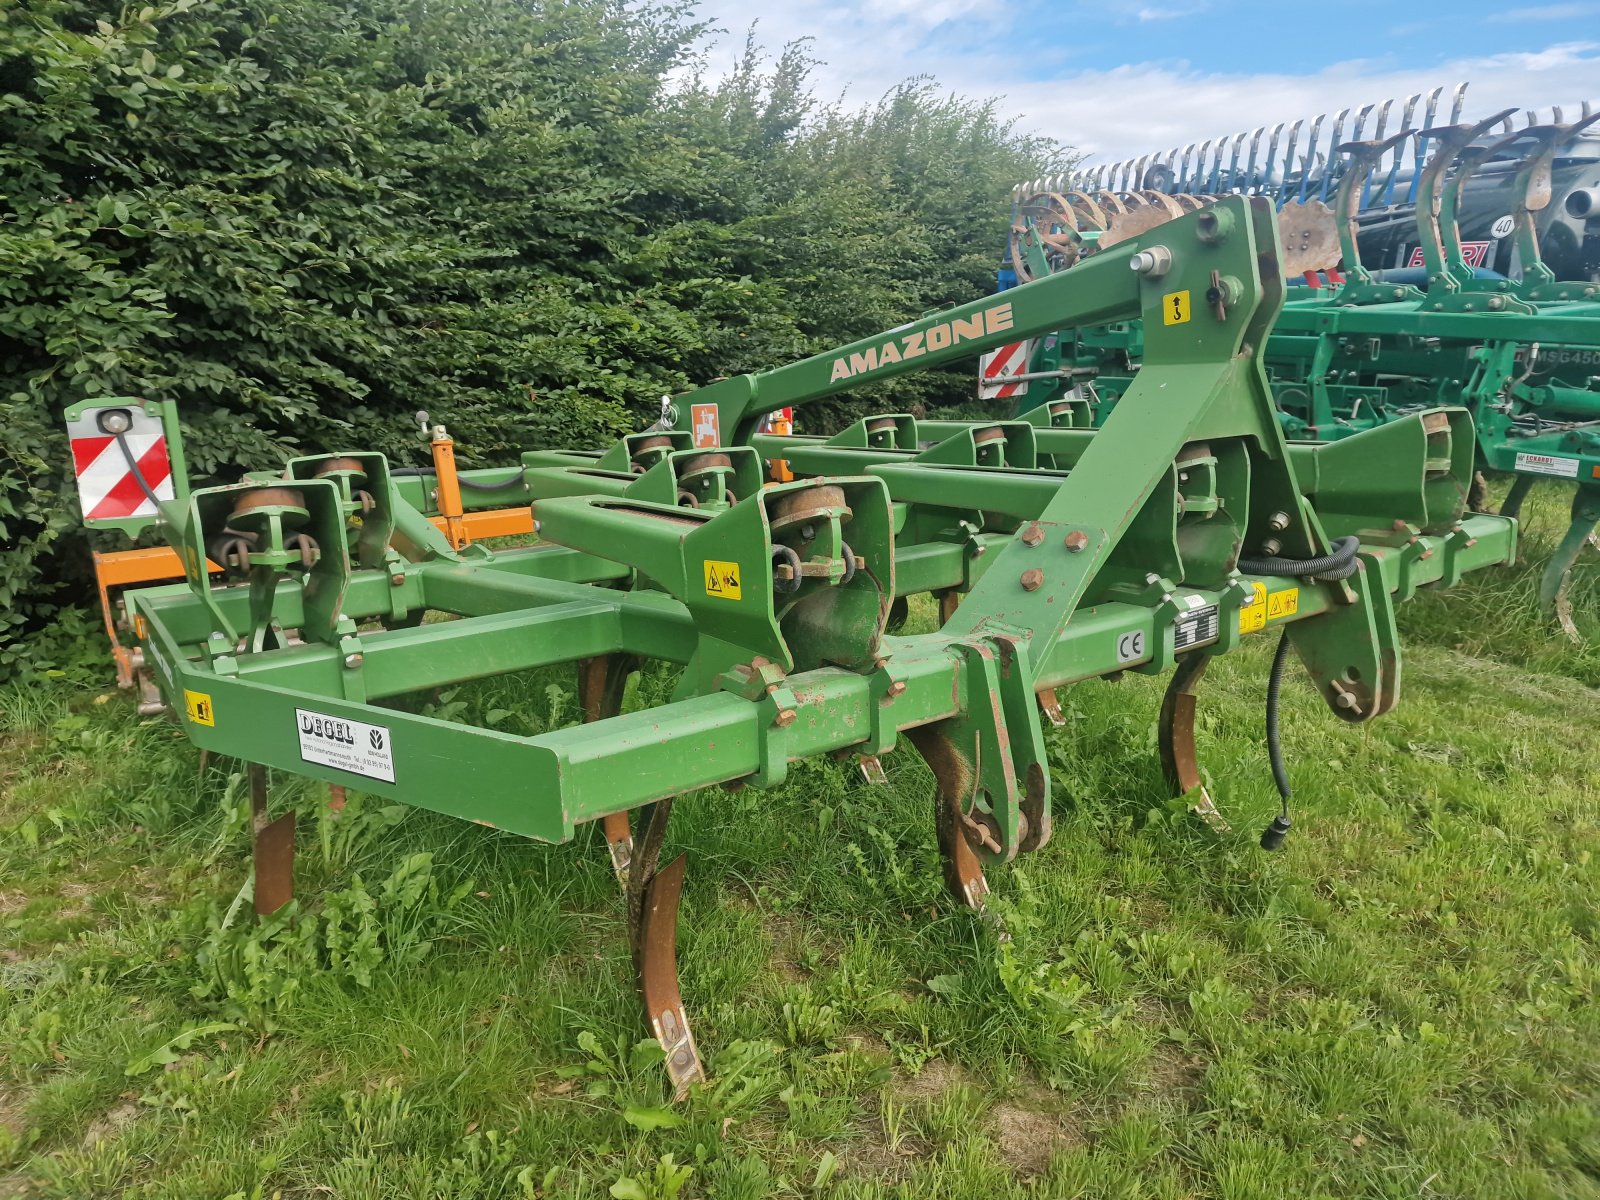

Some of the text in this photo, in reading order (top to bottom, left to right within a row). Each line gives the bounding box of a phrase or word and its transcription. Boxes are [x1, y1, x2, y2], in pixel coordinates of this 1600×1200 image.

[1495, 219, 1511, 234] 40
[830, 302, 1014, 384] AMAZONE
[1120, 633, 1141, 658] CE
[299, 713, 354, 745] DEGEL
